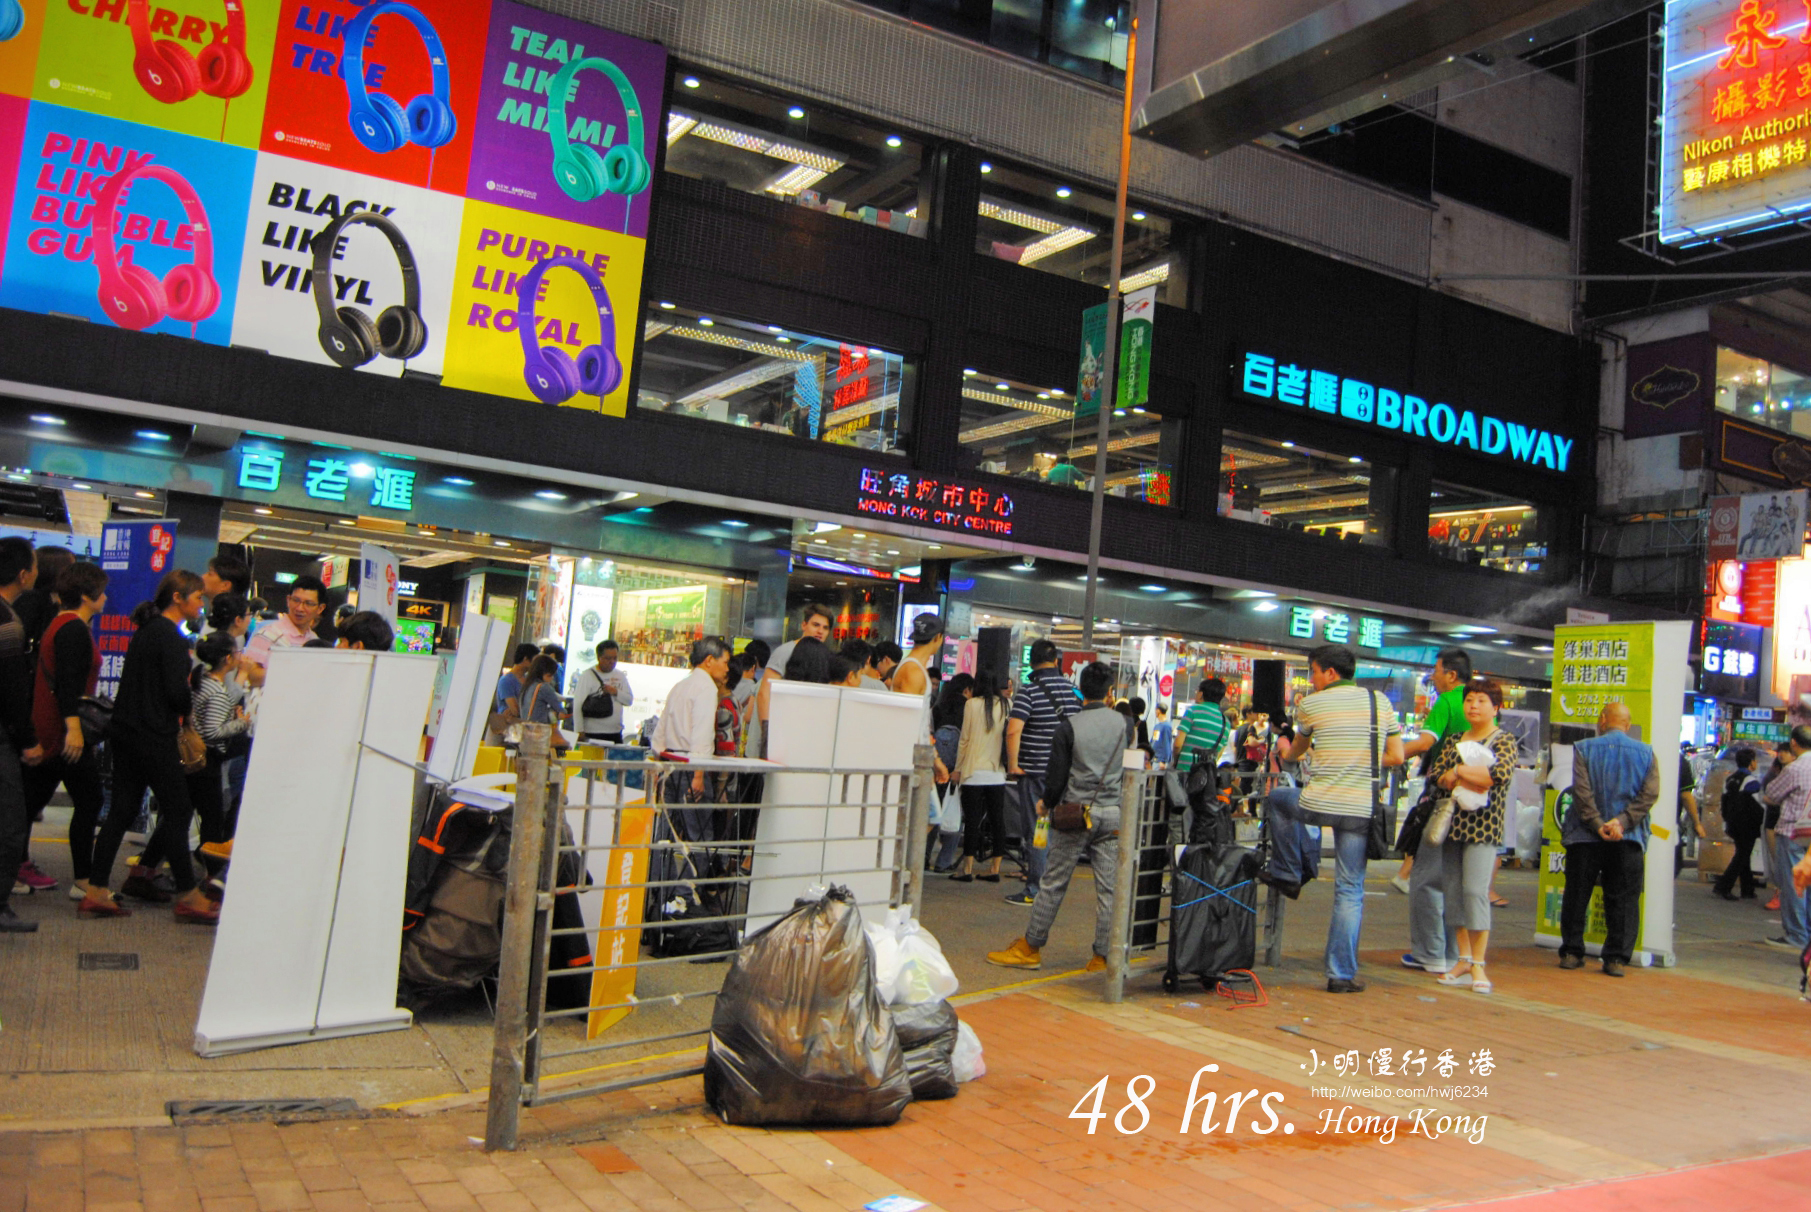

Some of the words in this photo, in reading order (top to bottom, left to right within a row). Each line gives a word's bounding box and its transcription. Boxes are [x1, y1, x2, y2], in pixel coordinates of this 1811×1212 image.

[68, 0, 229, 44] CHRRY
[496, 97, 616, 148] MIMI
[1684, 135, 1733, 162] Nikon
[1376, 387, 1573, 472] BROADWAY
[860, 467, 1014, 517] 旺角城市中心
[858, 497, 897, 516] MONG
[933, 509, 961, 526] CITY
[964, 515, 1013, 535] CENTRE
[406, 604, 432, 616] 4K
